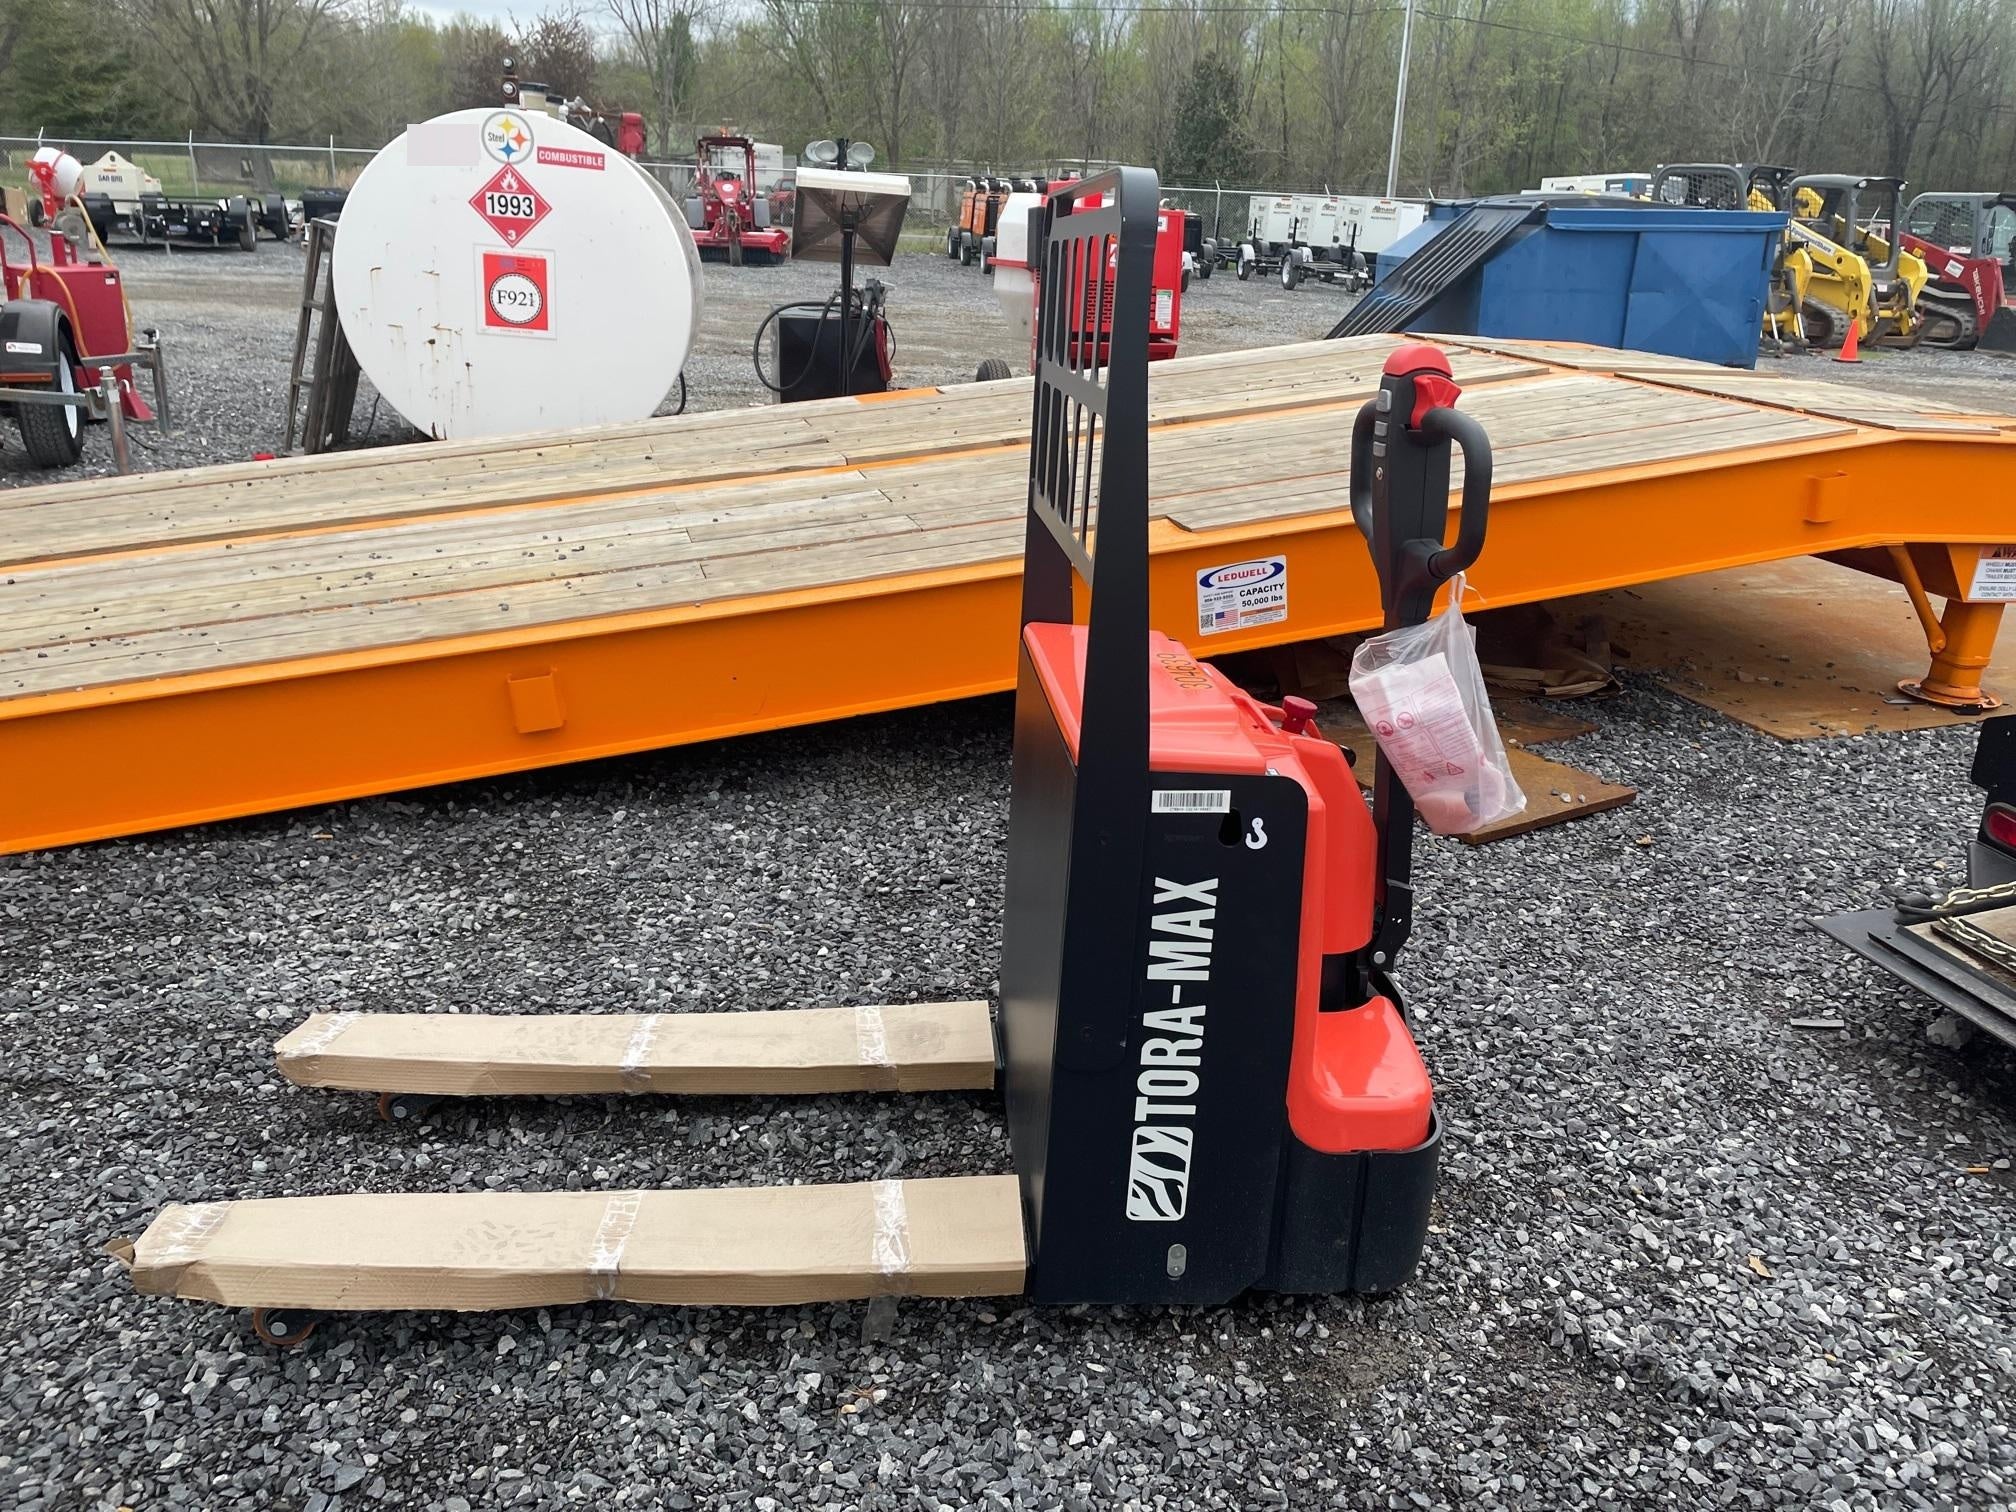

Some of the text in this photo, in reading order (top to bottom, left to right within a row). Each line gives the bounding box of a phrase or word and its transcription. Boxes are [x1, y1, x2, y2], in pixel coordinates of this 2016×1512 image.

[487, 132, 505, 143] Steel
[538, 150, 604, 167] COMBUSTIBLE
[487, 194, 534, 217] 1993
[507, 229, 517, 241] 3
[496, 289, 535, 307] F921
[1217, 567, 1268, 582] LEDWELL
[1239, 582, 1285, 598] CAPACITY
[1241, 596, 1269, 608] 50,000
[1270, 594, 1284, 603] lbs
[1134, 876, 1220, 1122] TORA-MAX
